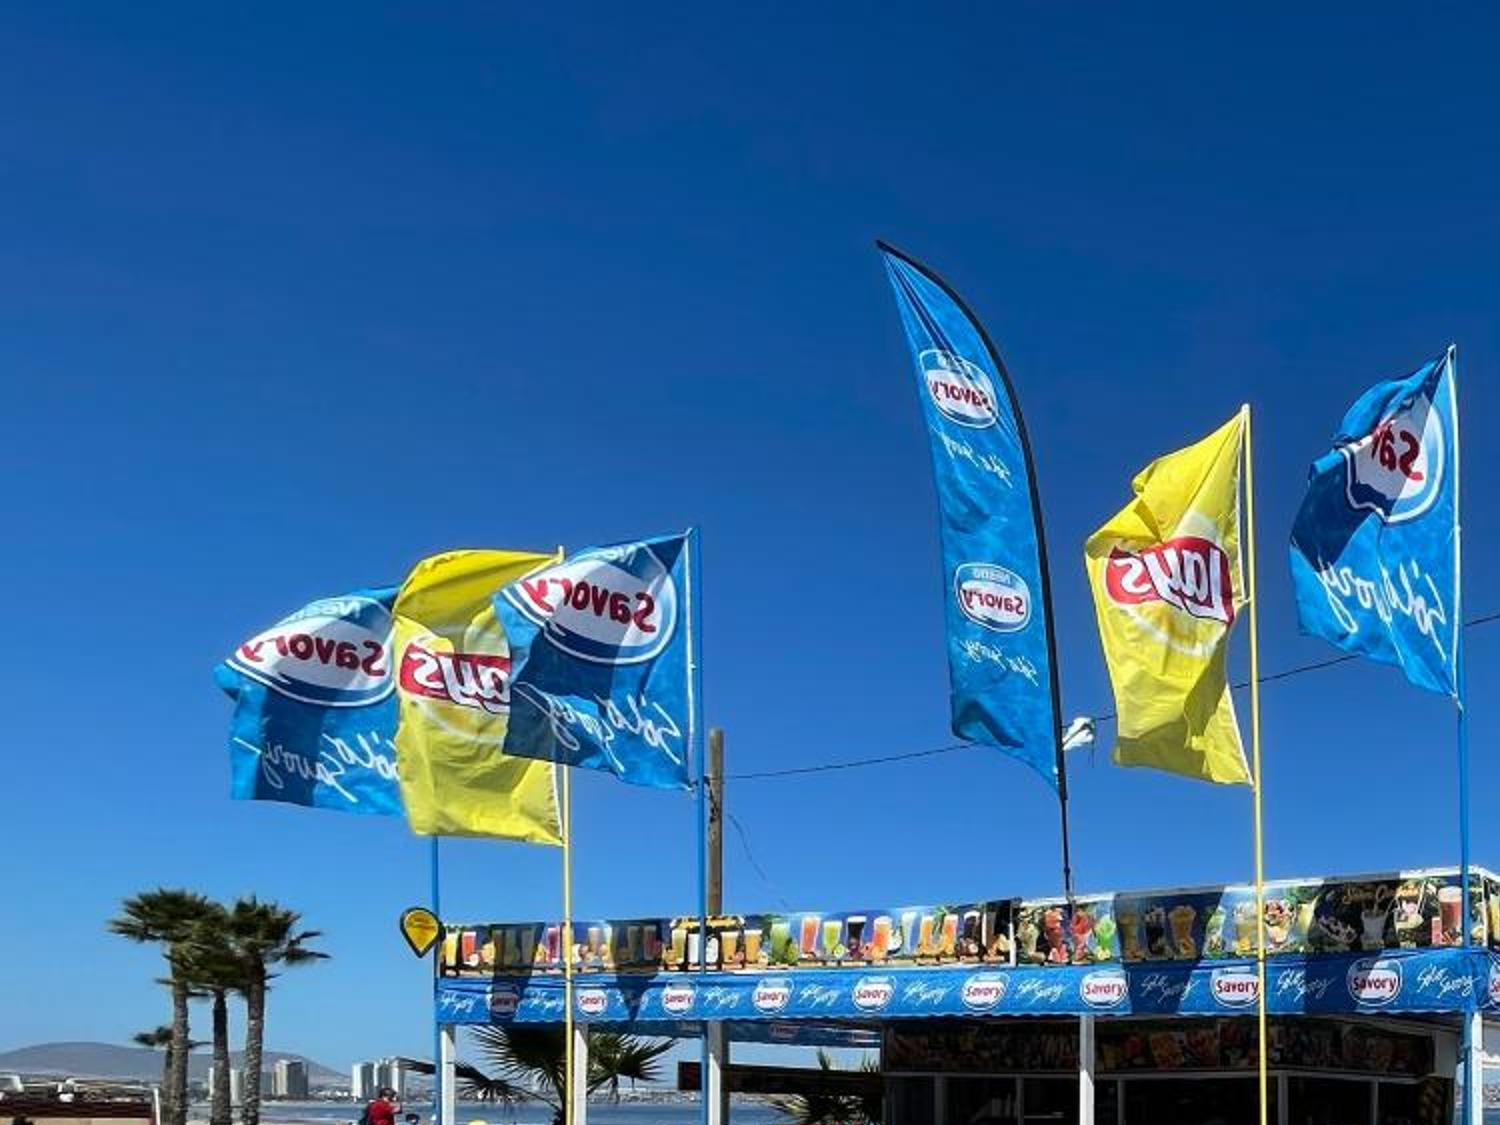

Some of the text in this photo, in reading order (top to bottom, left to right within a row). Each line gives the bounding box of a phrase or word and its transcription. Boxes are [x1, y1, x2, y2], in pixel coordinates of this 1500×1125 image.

[1084, 982, 1124, 996] Savory
[1215, 980, 1259, 995] Savory
[1351, 977, 1395, 992] Savory
[757, 991, 786, 1003] Savory
[856, 988, 889, 1001] Savory
[965, 985, 1000, 998] Savory
